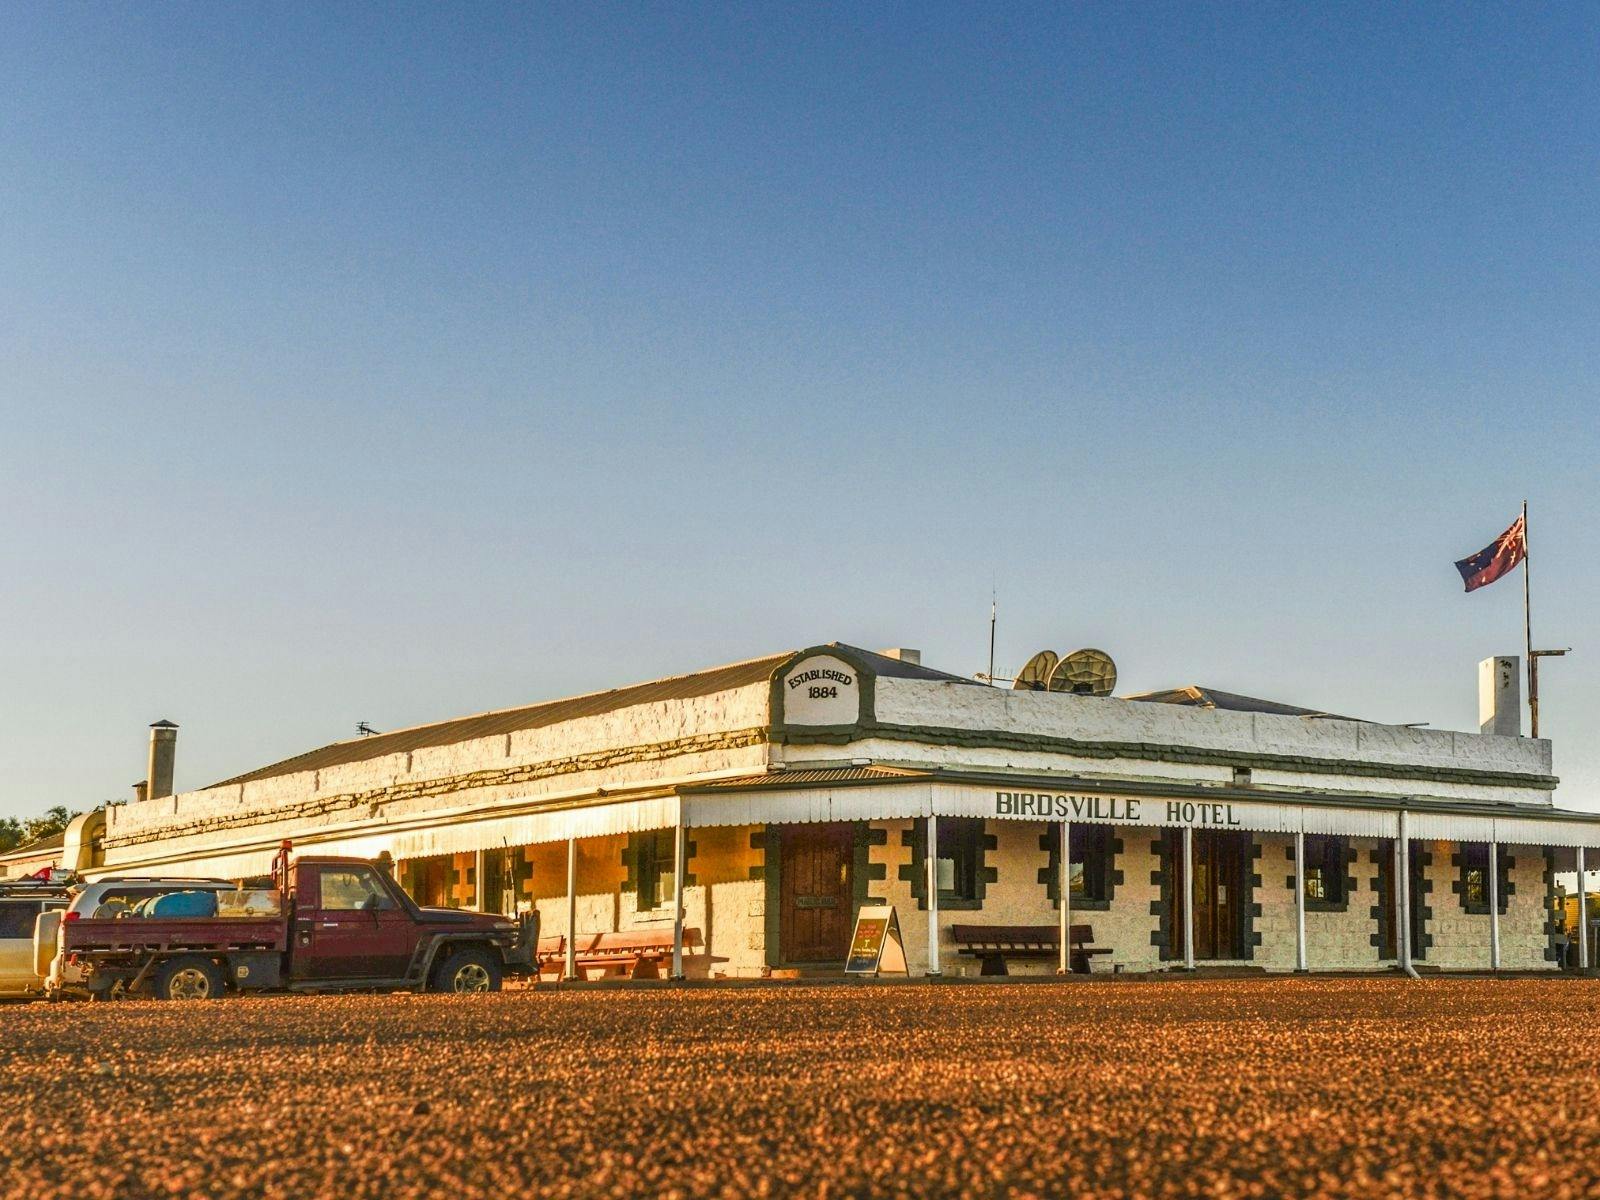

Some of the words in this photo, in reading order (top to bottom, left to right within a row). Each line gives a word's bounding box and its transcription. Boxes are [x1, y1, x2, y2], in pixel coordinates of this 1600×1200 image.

[788, 669, 852, 689] ESTABLISHED
[808, 686, 838, 698] 1884
[996, 791, 1141, 820] BIRDSVILLE
[1166, 801, 1240, 825] HOTEL
